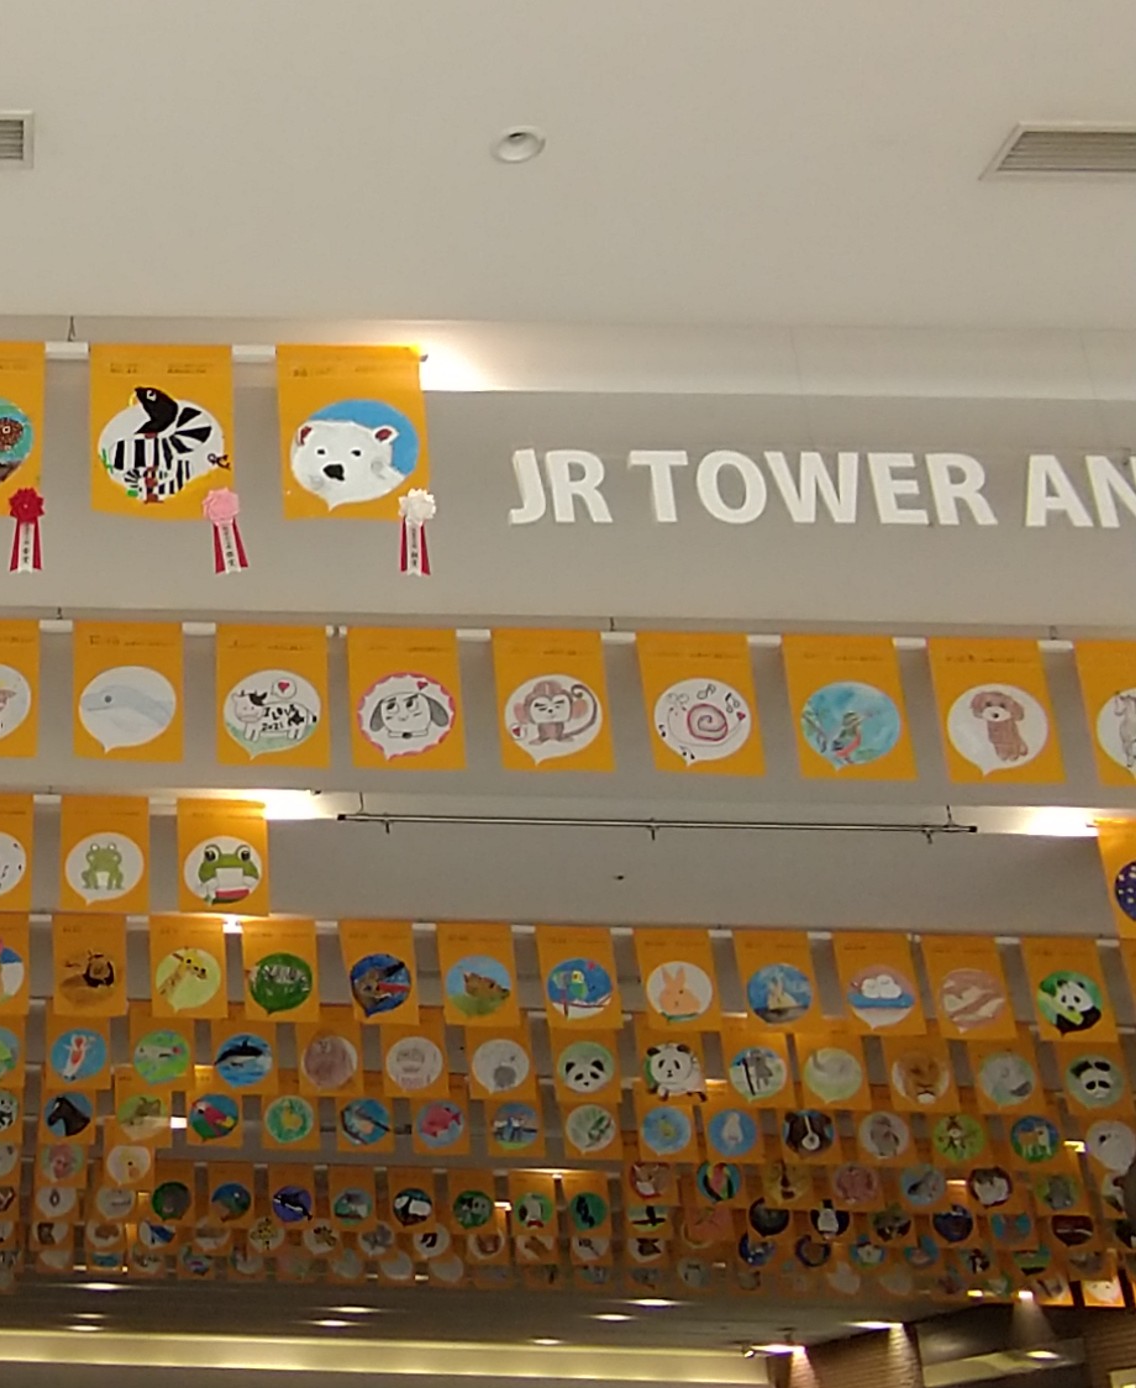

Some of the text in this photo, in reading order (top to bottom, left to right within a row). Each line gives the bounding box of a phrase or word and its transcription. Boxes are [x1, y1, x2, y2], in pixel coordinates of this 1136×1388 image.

[509, 448, 1136, 528] JR TOWER AN
